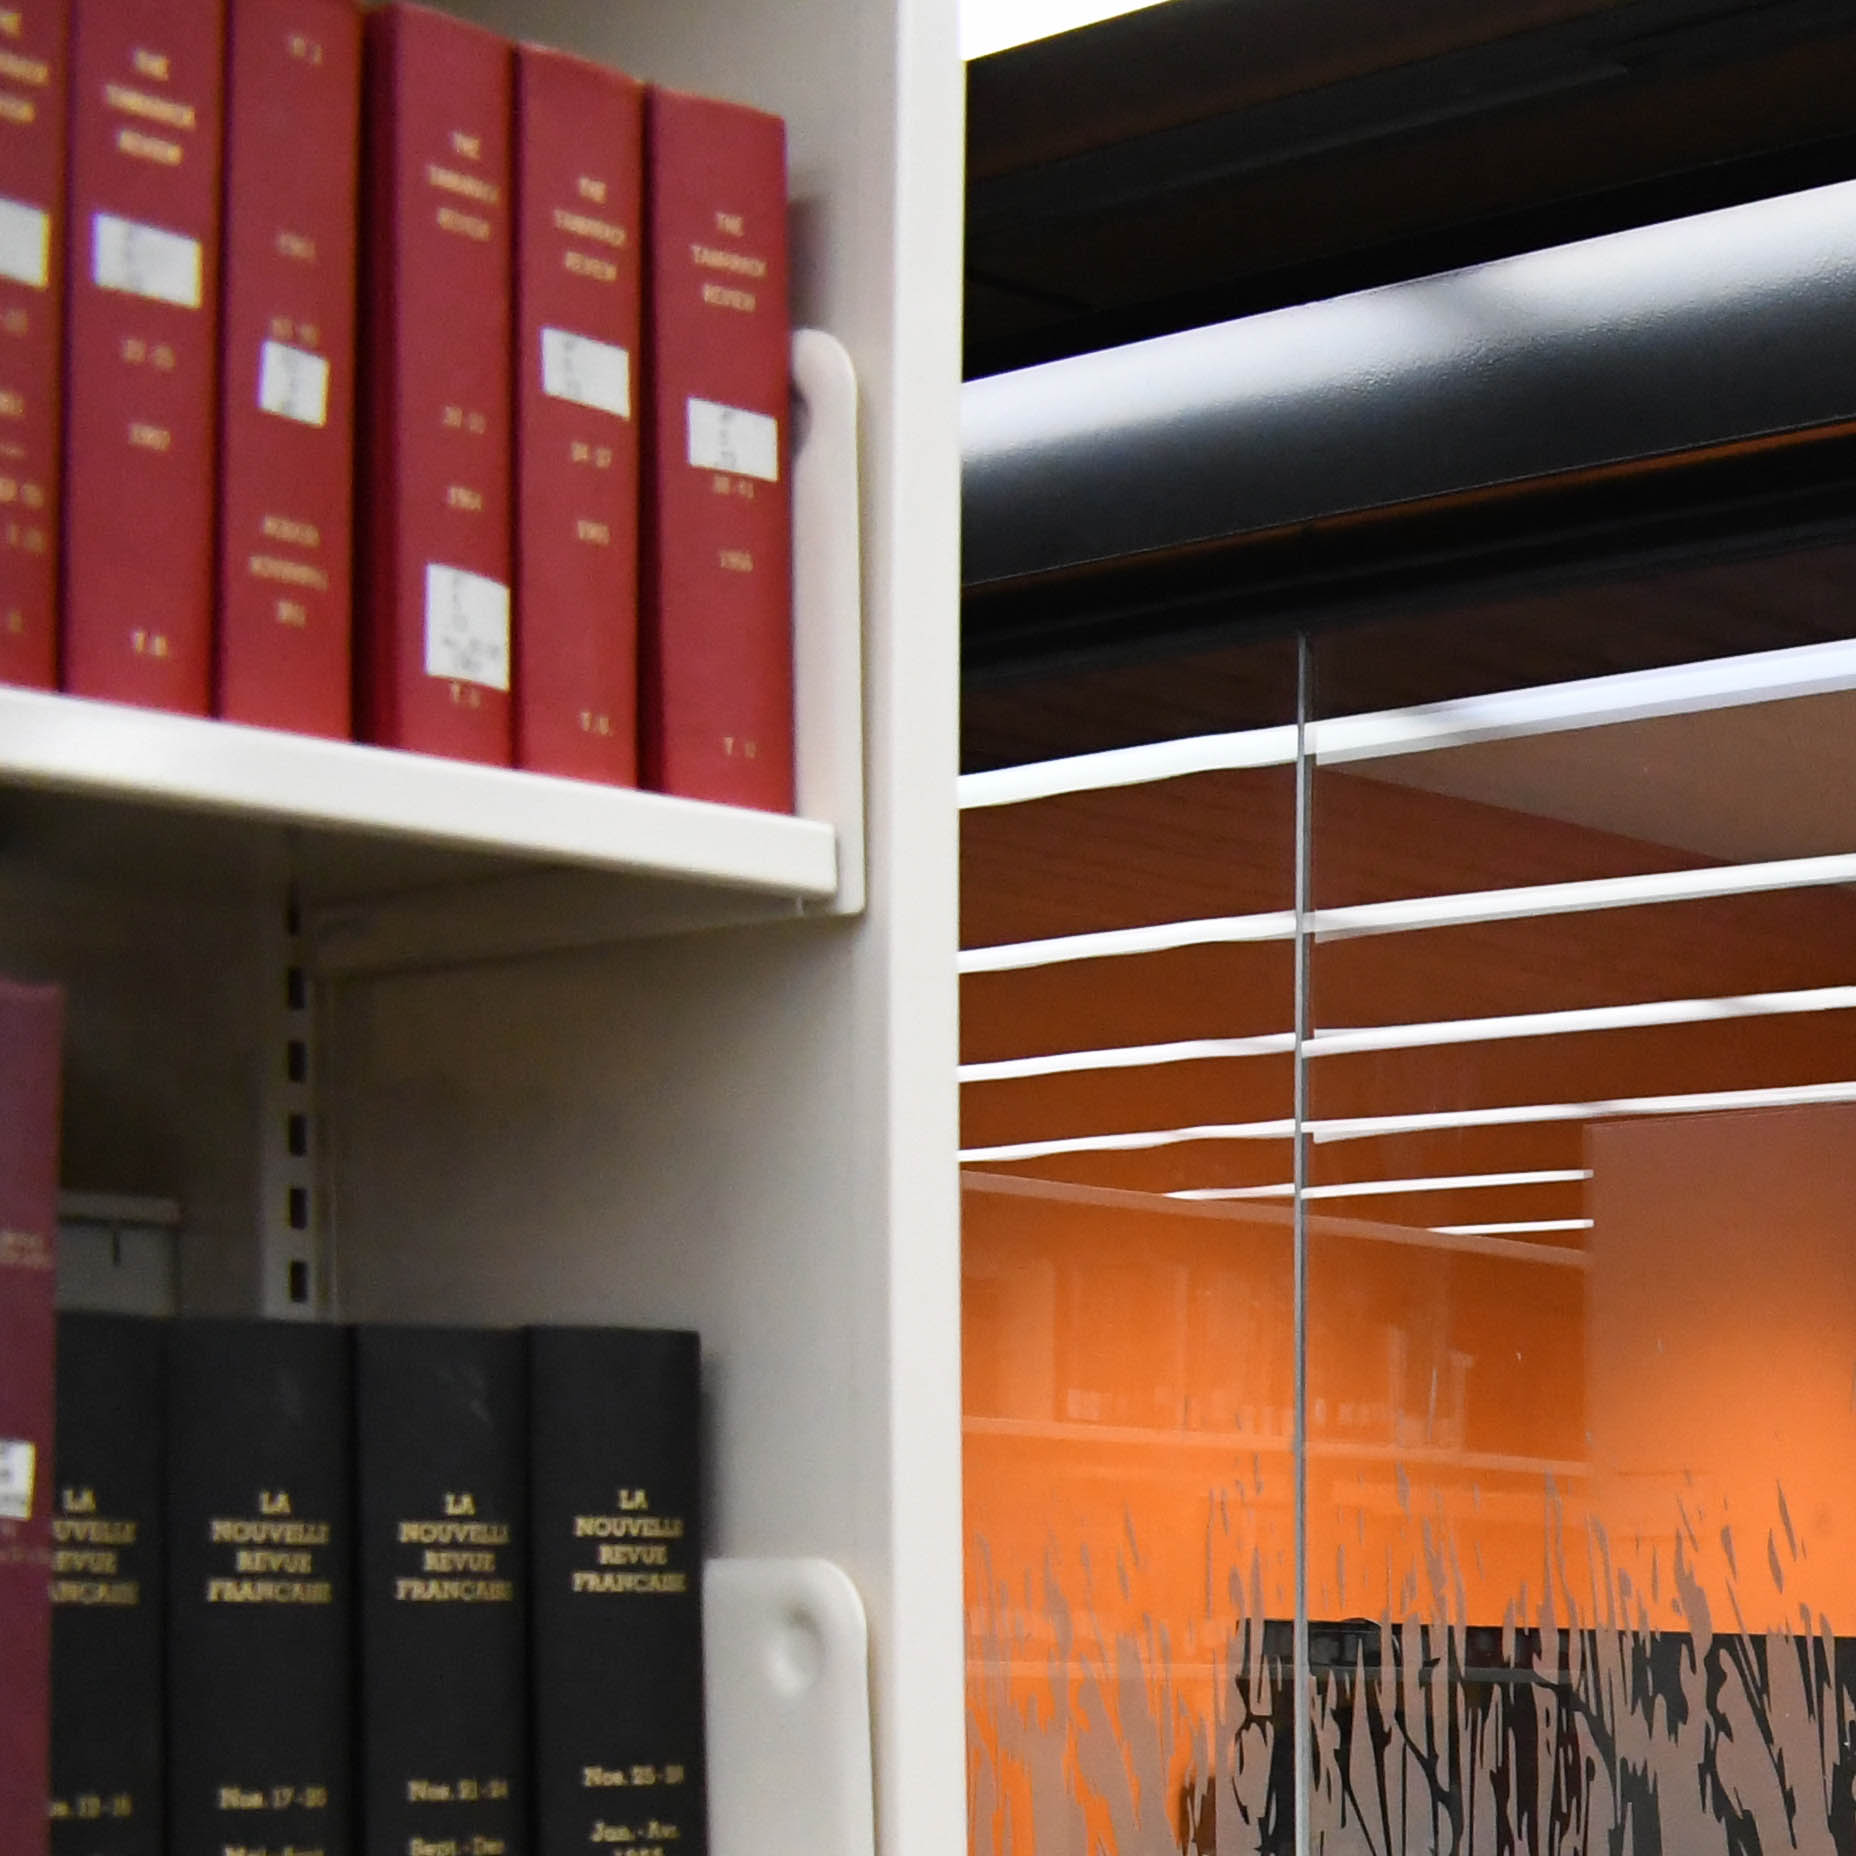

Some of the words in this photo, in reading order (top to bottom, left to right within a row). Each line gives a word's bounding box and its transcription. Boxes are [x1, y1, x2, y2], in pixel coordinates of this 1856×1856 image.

[259, 1490, 293, 1515] LA
[444, 1492, 476, 1516] LA
[617, 1488, 649, 1511] LA
